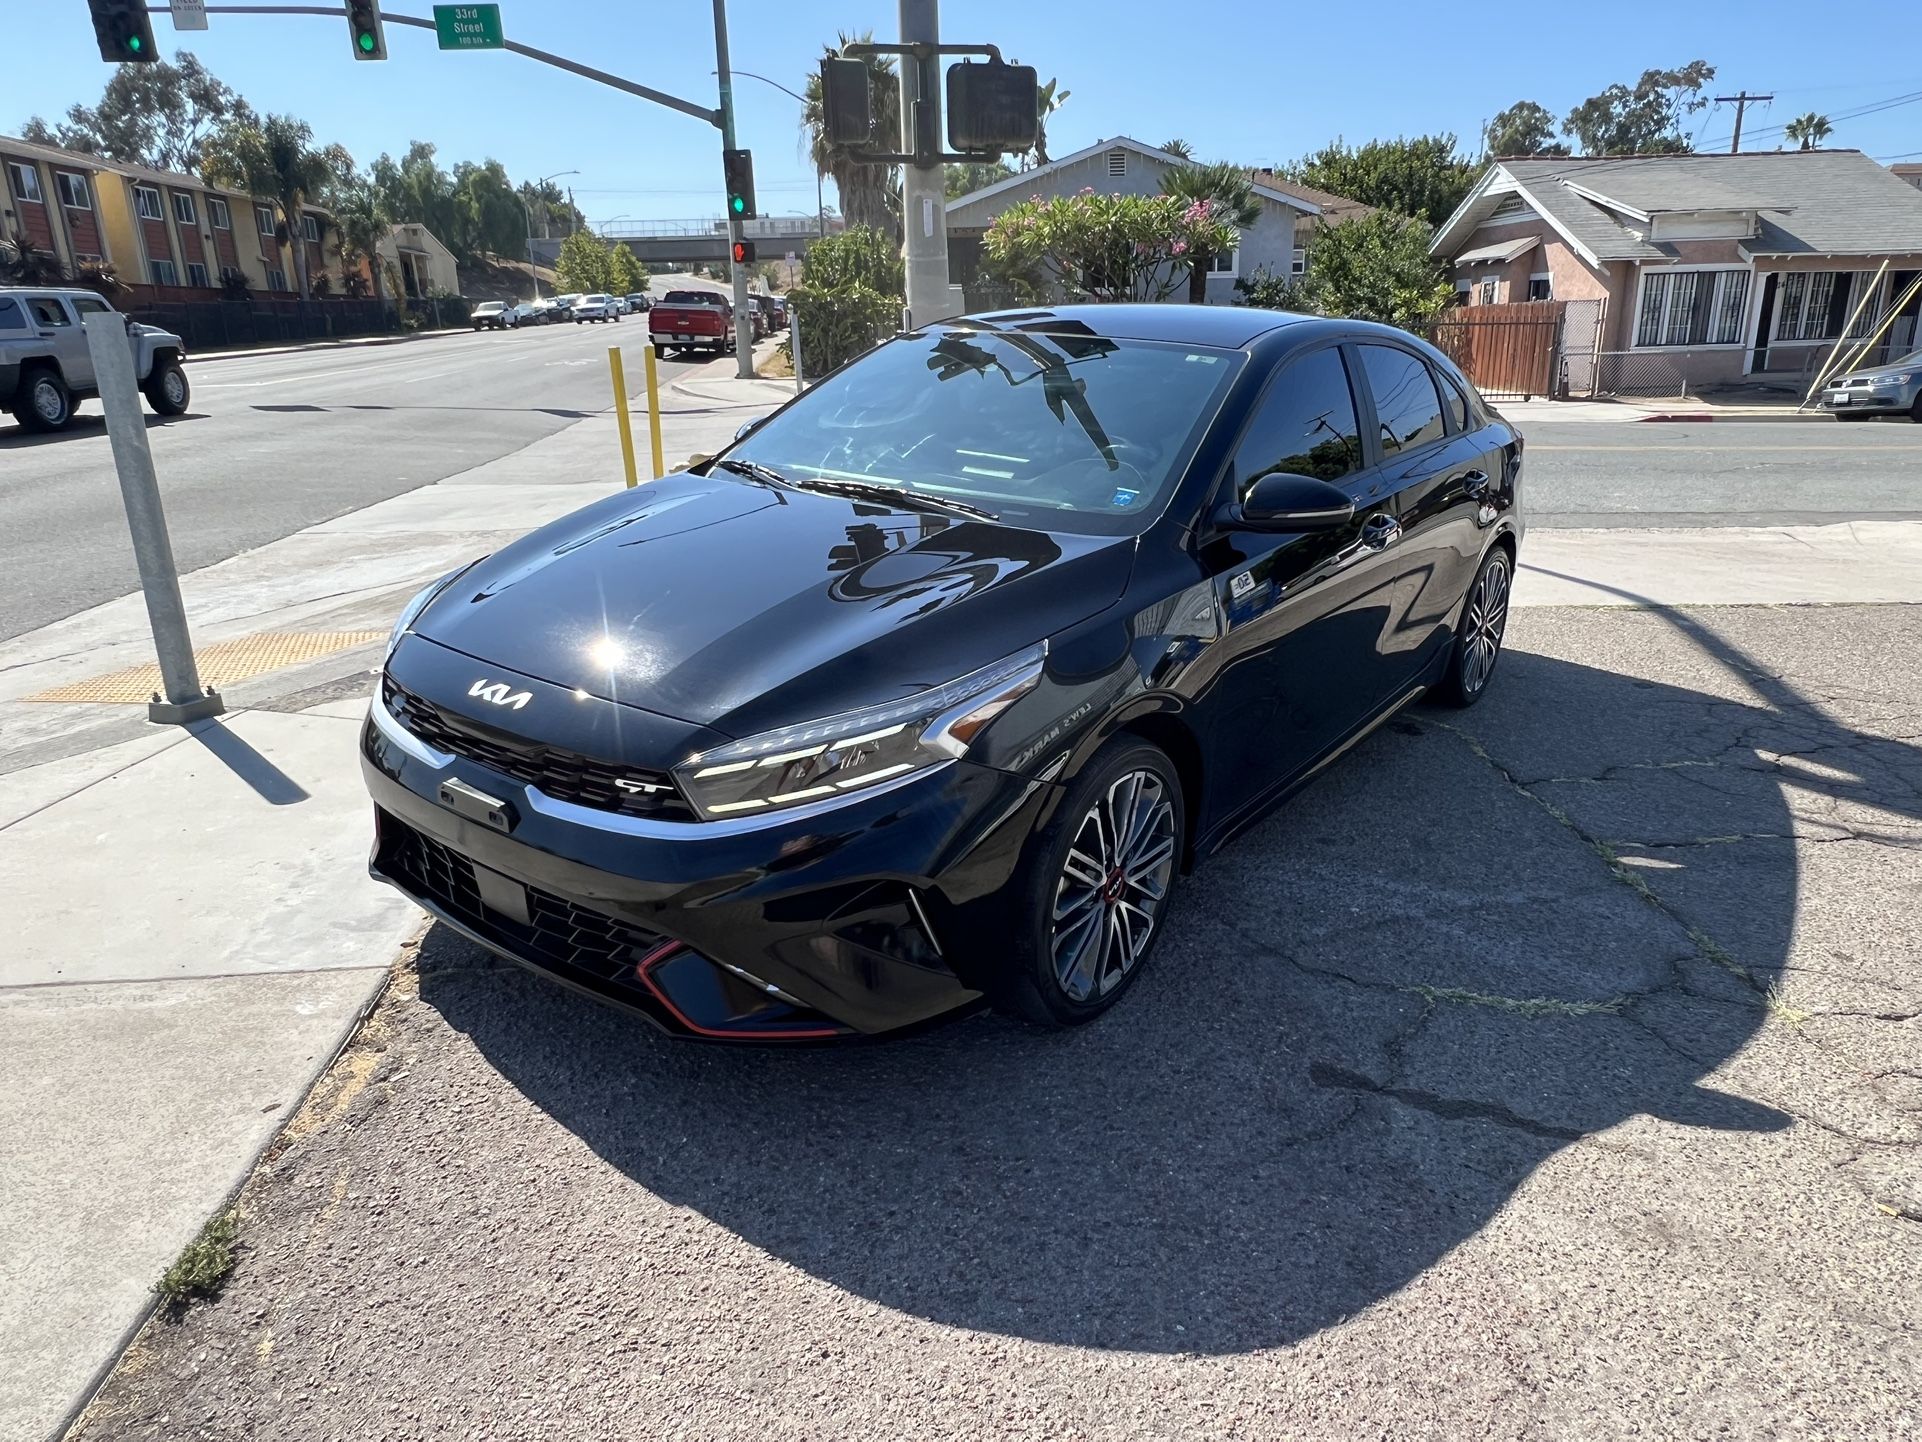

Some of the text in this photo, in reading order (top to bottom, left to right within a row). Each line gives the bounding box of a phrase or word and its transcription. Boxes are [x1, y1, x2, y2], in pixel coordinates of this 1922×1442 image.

[455, 8, 478, 19] 33rd
[453, 22, 484, 33] Street
[467, 678, 534, 710] KIA
[614, 778, 675, 793] GT
